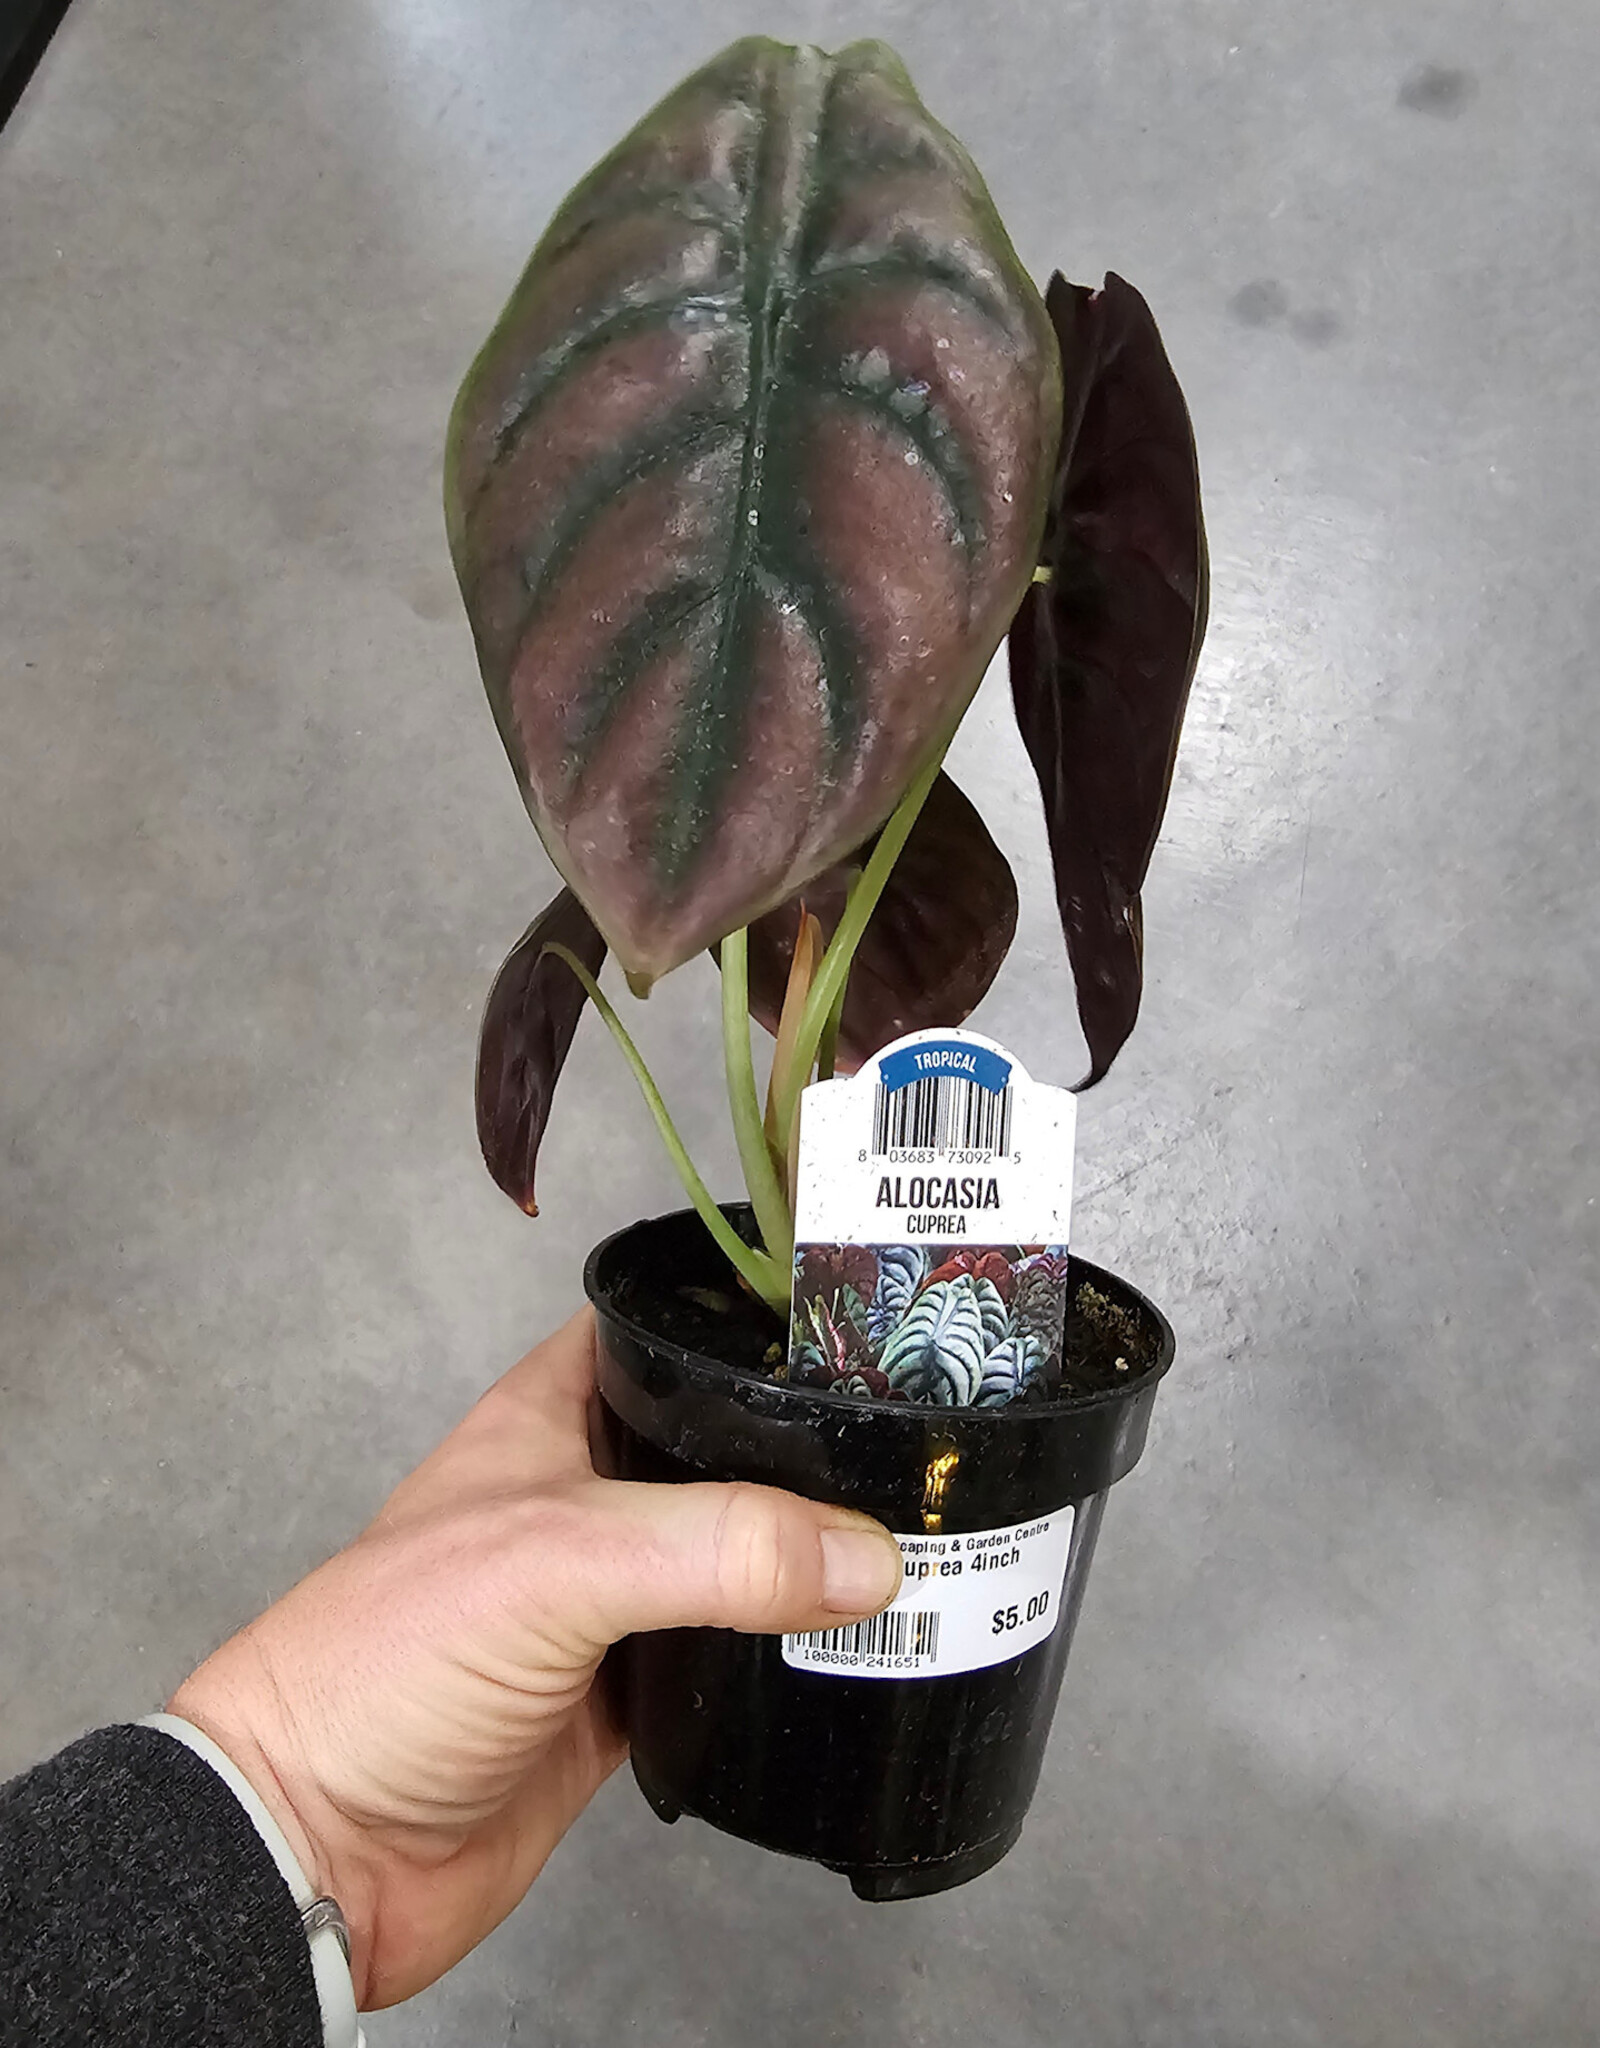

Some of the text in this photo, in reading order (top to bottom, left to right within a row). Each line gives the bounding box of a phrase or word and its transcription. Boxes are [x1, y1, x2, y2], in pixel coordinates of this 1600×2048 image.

[914, 1050, 976, 1073] TROPICAL
[858, 1149, 1021, 1165] 8 03683 73092 5
[876, 1176, 1000, 1209] ALOCASIA
[907, 1214, 966, 1234] CUPREA
[898, 1521, 1050, 1555] caping & Garden Centre
[970, 1547, 1020, 1573] 4inch
[992, 1590, 1050, 1635] $5.00
[803, 1649, 921, 1669] 100000 241651
